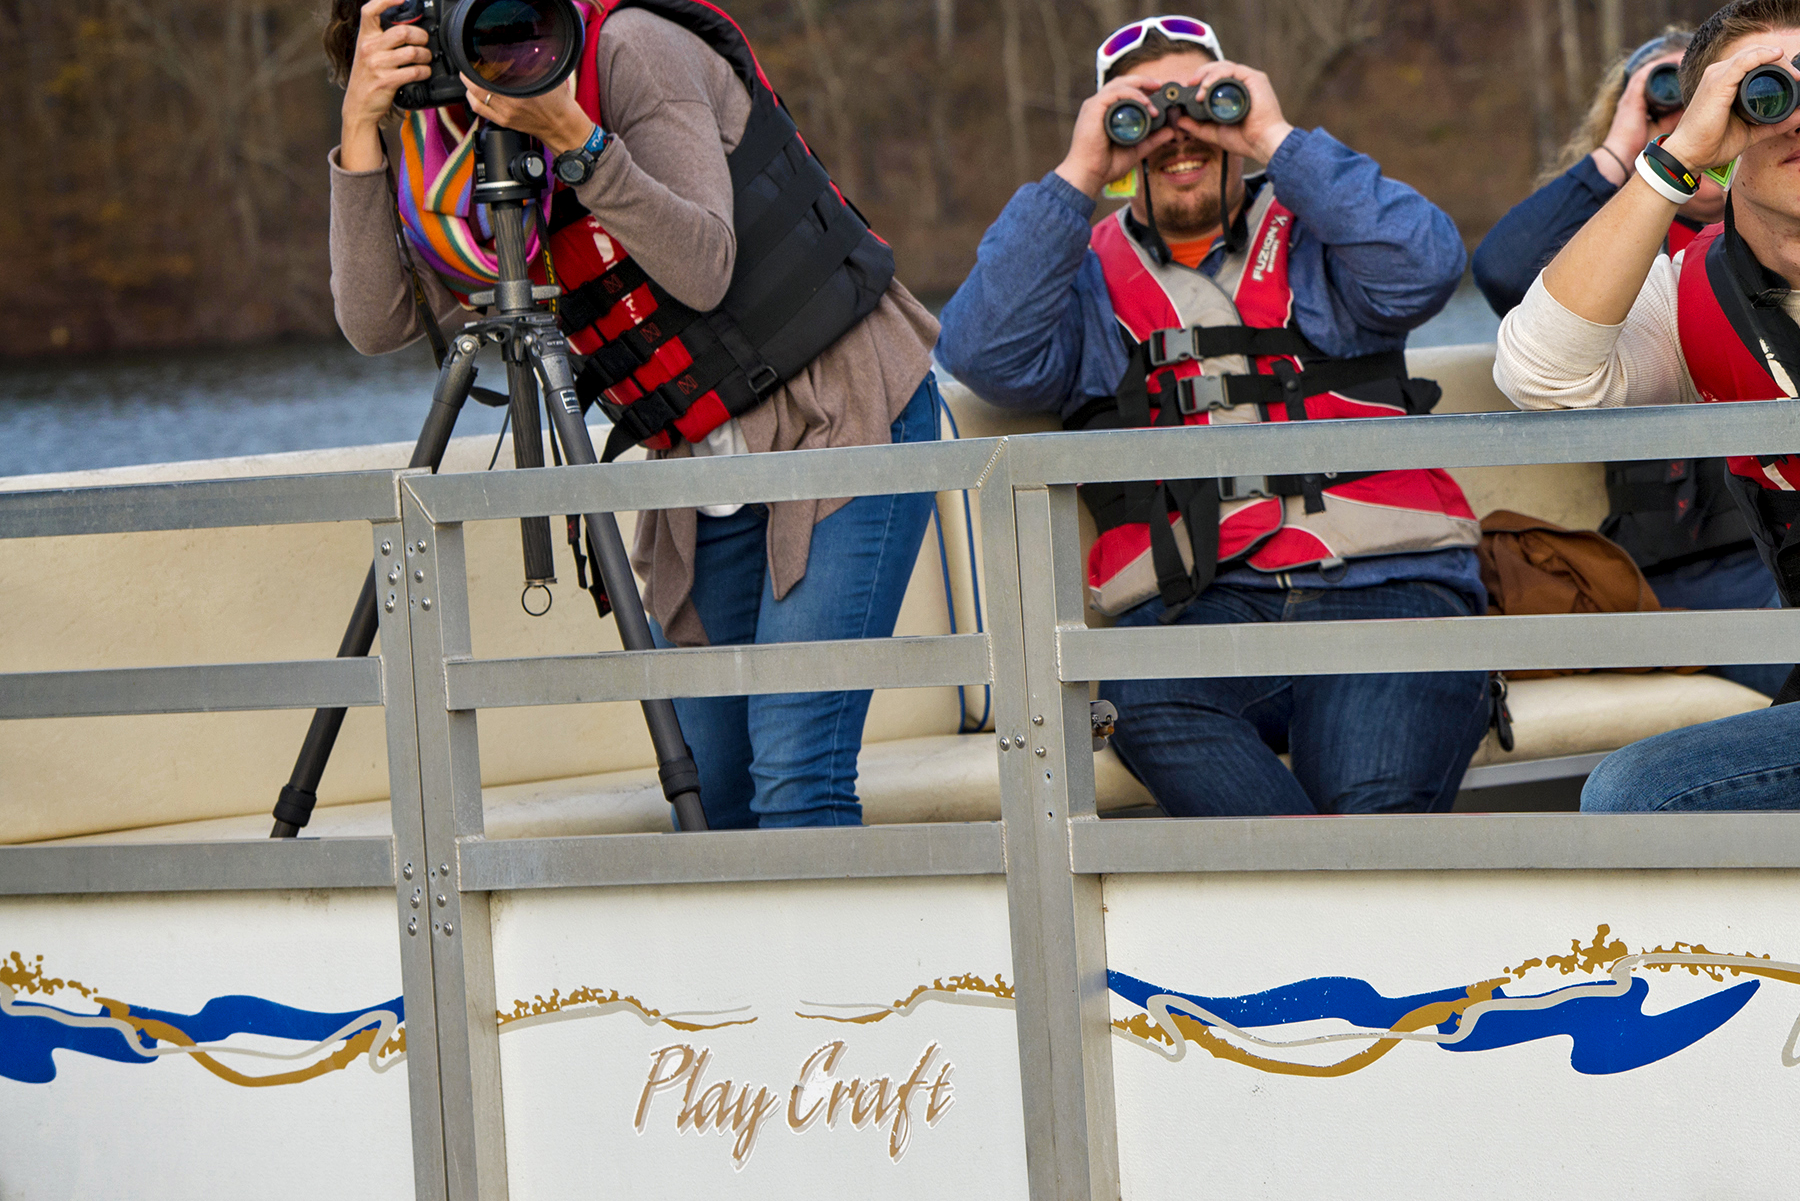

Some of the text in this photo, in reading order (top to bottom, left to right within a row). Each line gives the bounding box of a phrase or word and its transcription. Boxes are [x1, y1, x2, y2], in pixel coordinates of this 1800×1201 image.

[1252, 226, 1279, 281] FUZION
[633, 1038, 956, 1172] Play Craft
